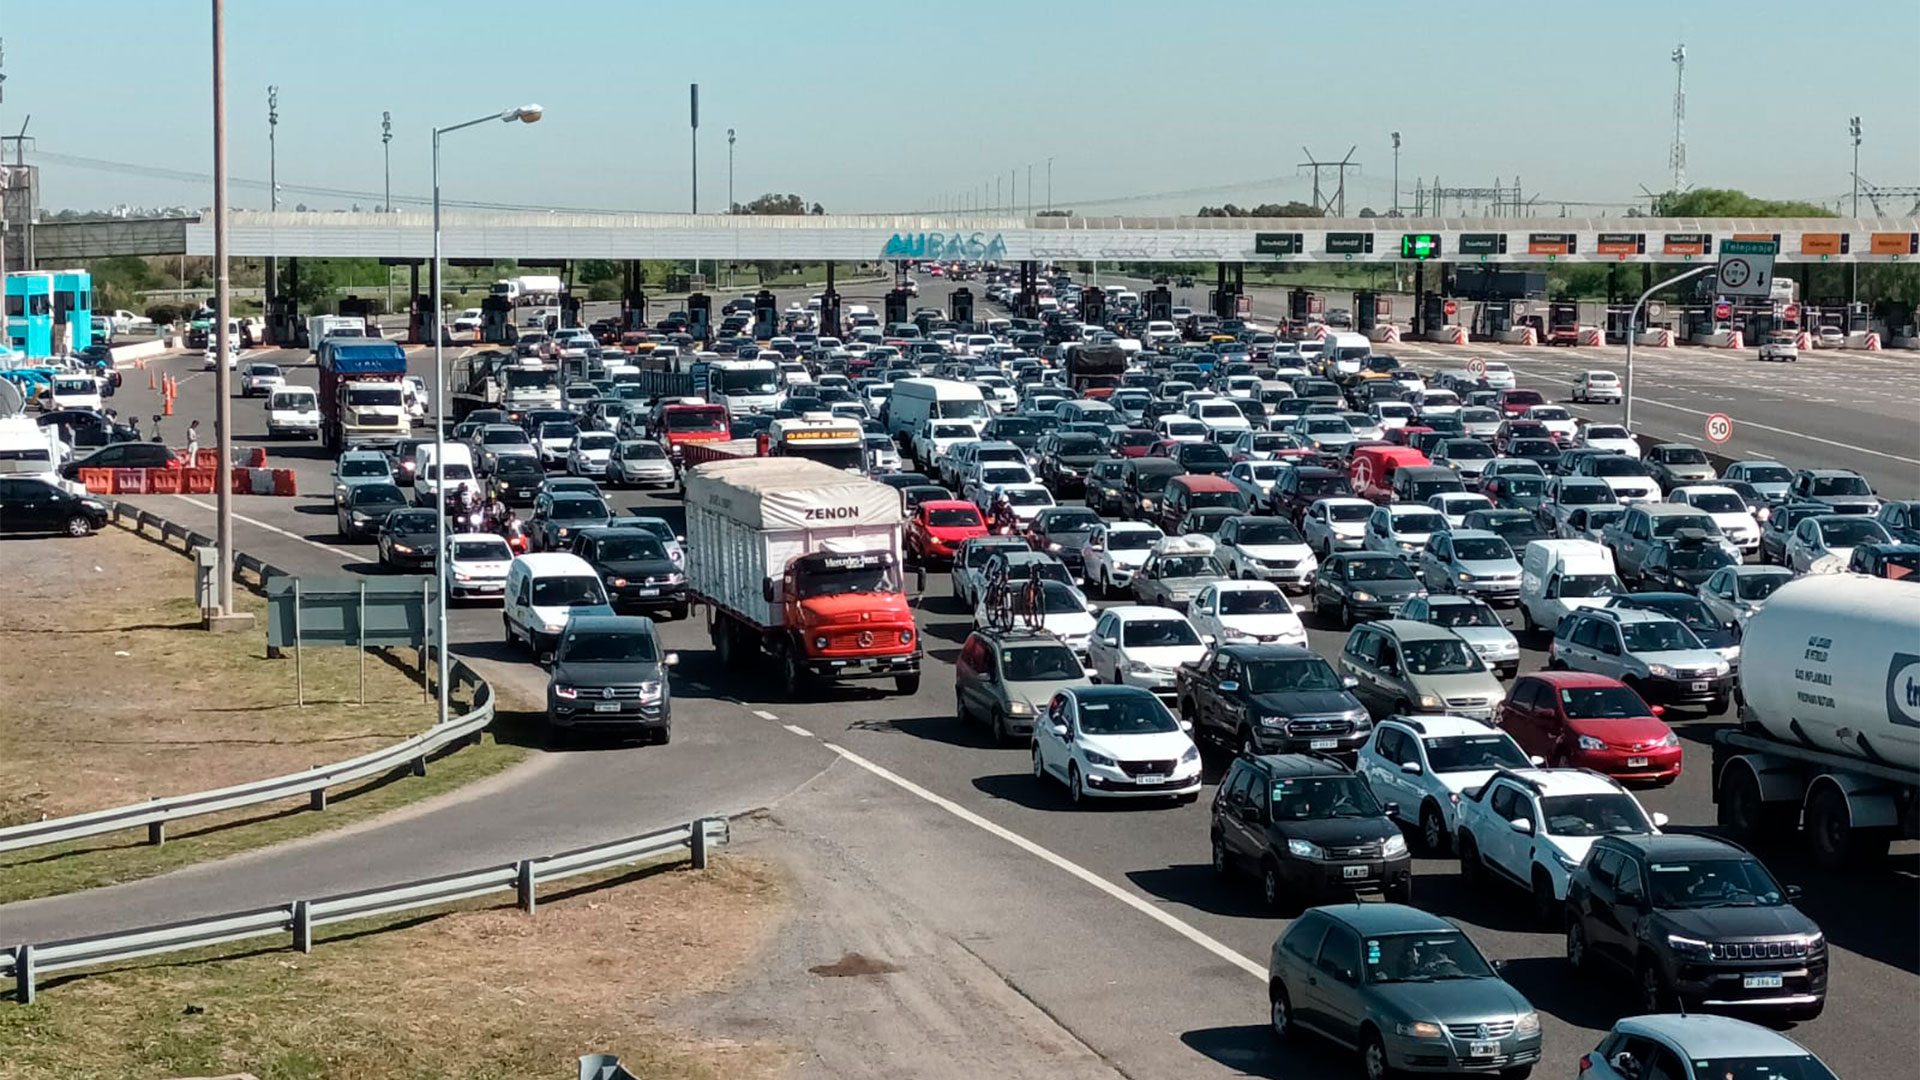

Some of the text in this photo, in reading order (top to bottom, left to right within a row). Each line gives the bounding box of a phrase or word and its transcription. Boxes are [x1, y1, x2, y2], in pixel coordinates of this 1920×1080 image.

[886, 231, 1007, 256] AUBASA
[1470, 363, 1483, 373] 40
[1711, 422, 1727, 435] 50
[804, 506, 859, 520] ZENON
